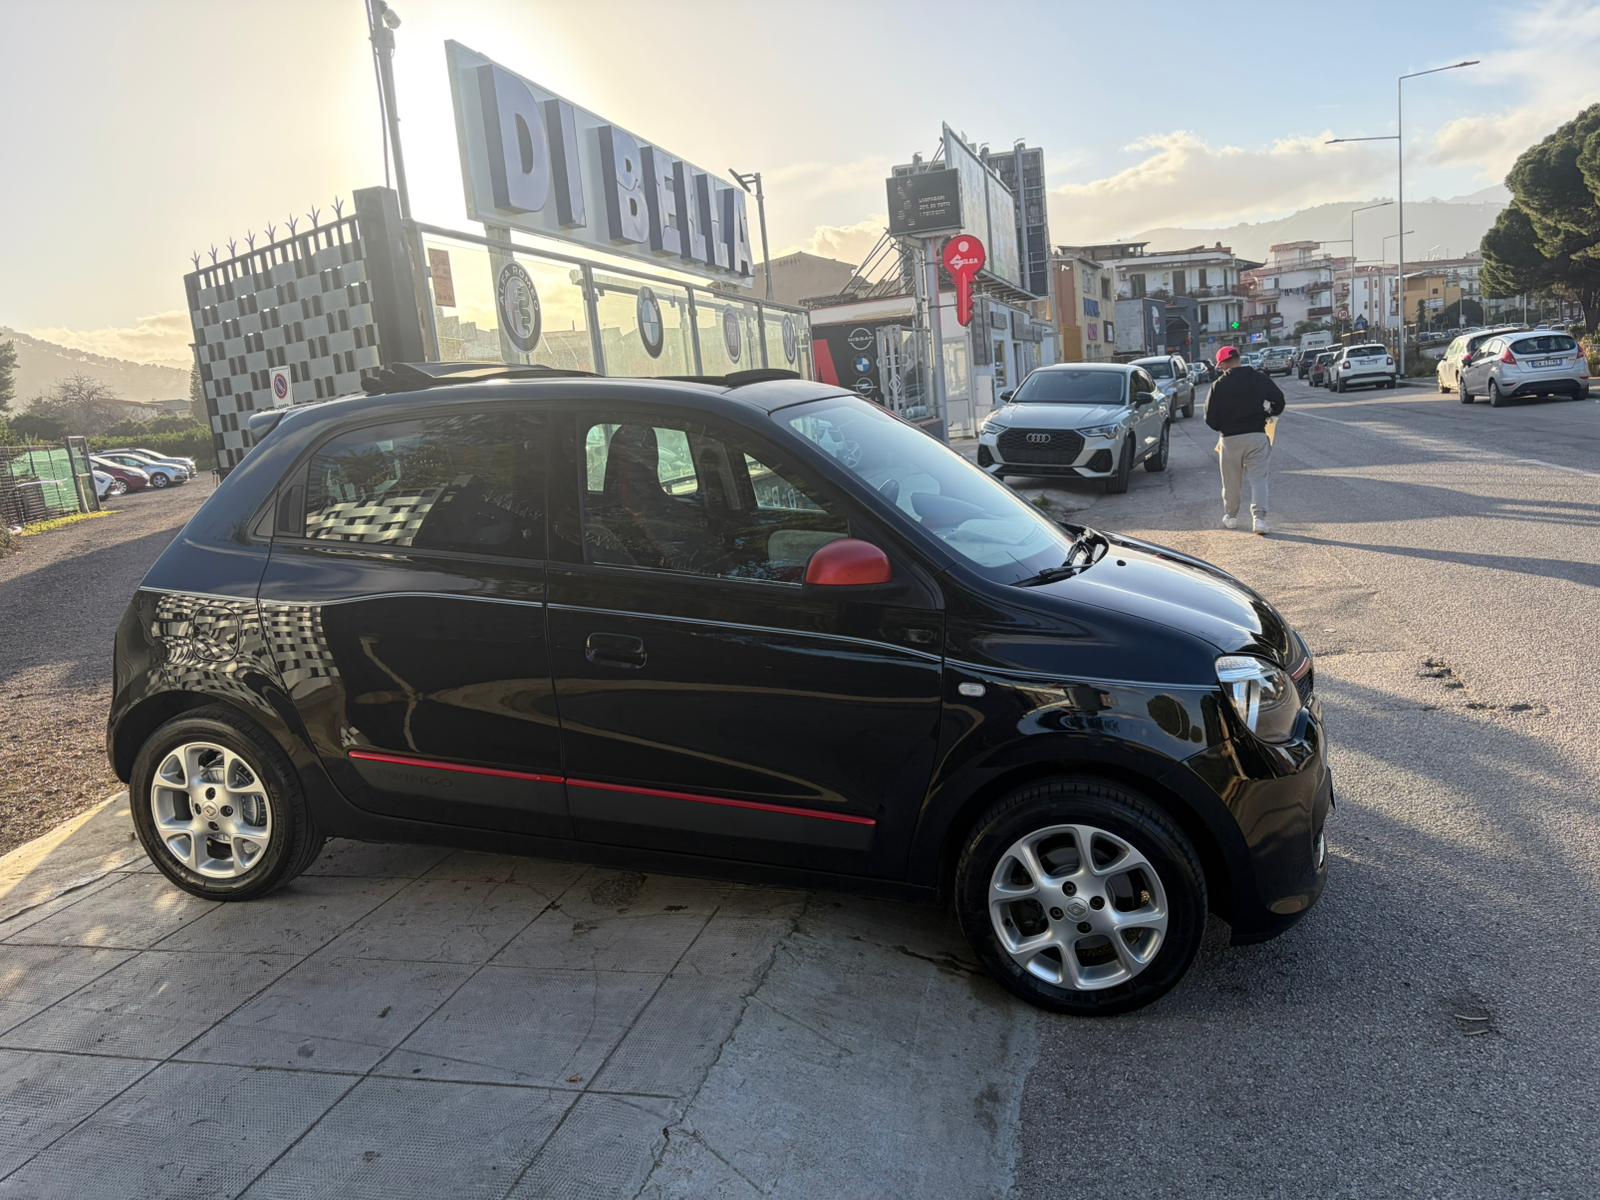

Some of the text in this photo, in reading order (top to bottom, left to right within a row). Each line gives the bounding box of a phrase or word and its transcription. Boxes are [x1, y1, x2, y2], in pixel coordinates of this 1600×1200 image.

[478, 63, 755, 278] DI BELLA
[499, 270, 510, 306] ALFA
[512, 265, 539, 311] ROMEO
